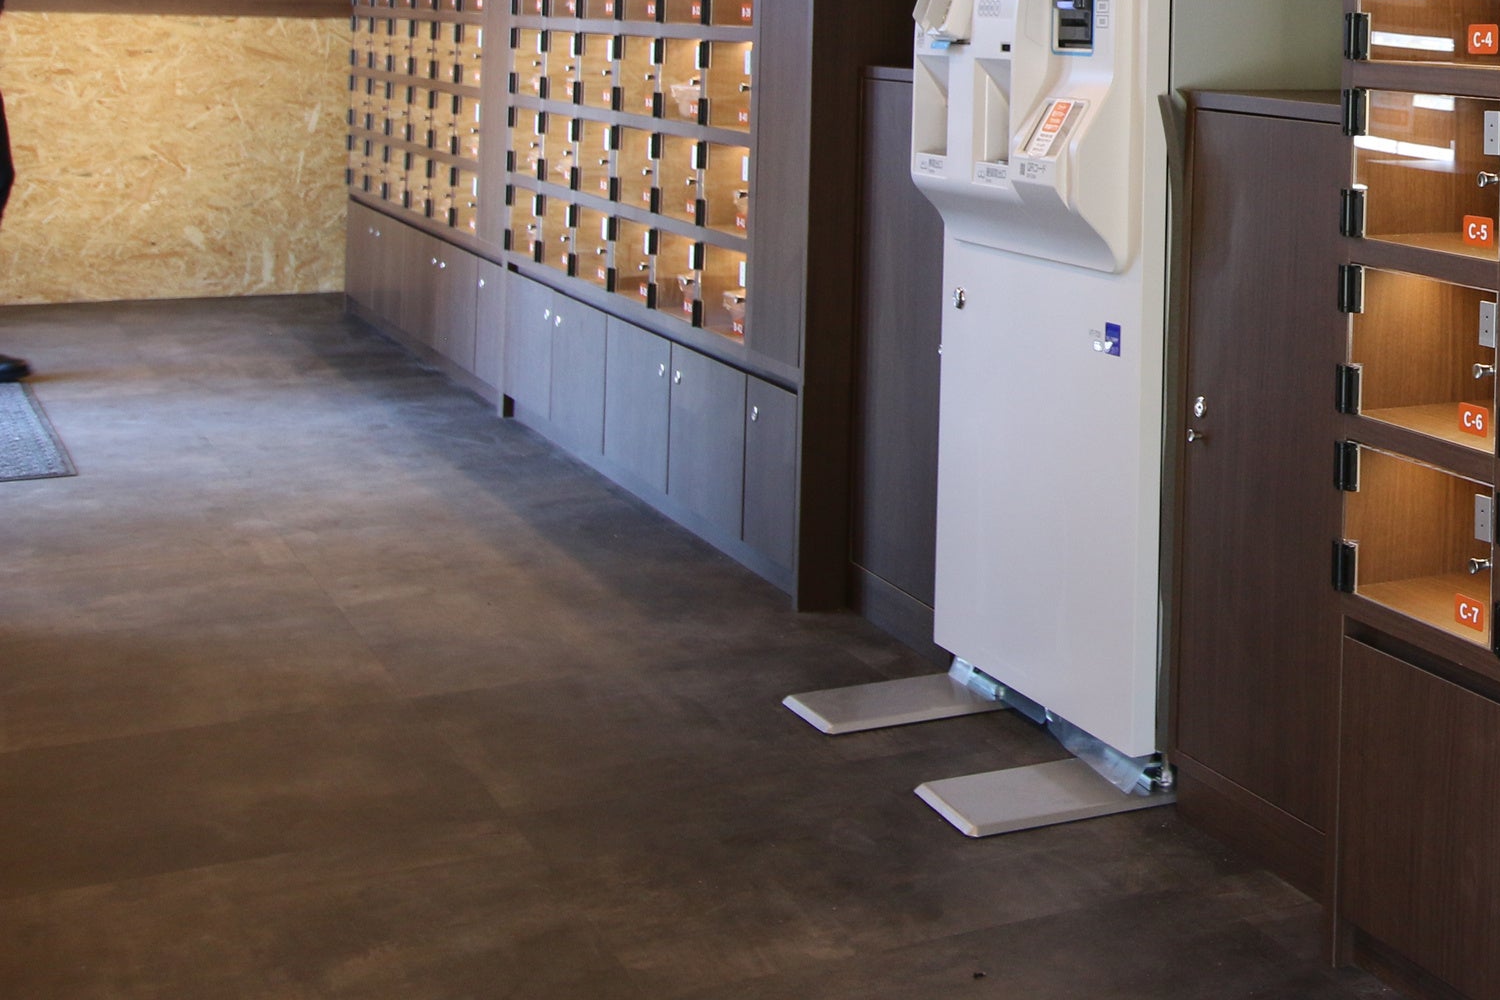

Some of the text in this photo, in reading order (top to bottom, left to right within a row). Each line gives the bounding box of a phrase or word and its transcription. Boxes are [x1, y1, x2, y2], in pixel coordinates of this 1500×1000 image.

[1473, 31, 1493, 48] C-4
[1468, 222, 1488, 241] C-5
[1463, 411, 1483, 431] C-6
[1459, 602, 1479, 623] C-7
